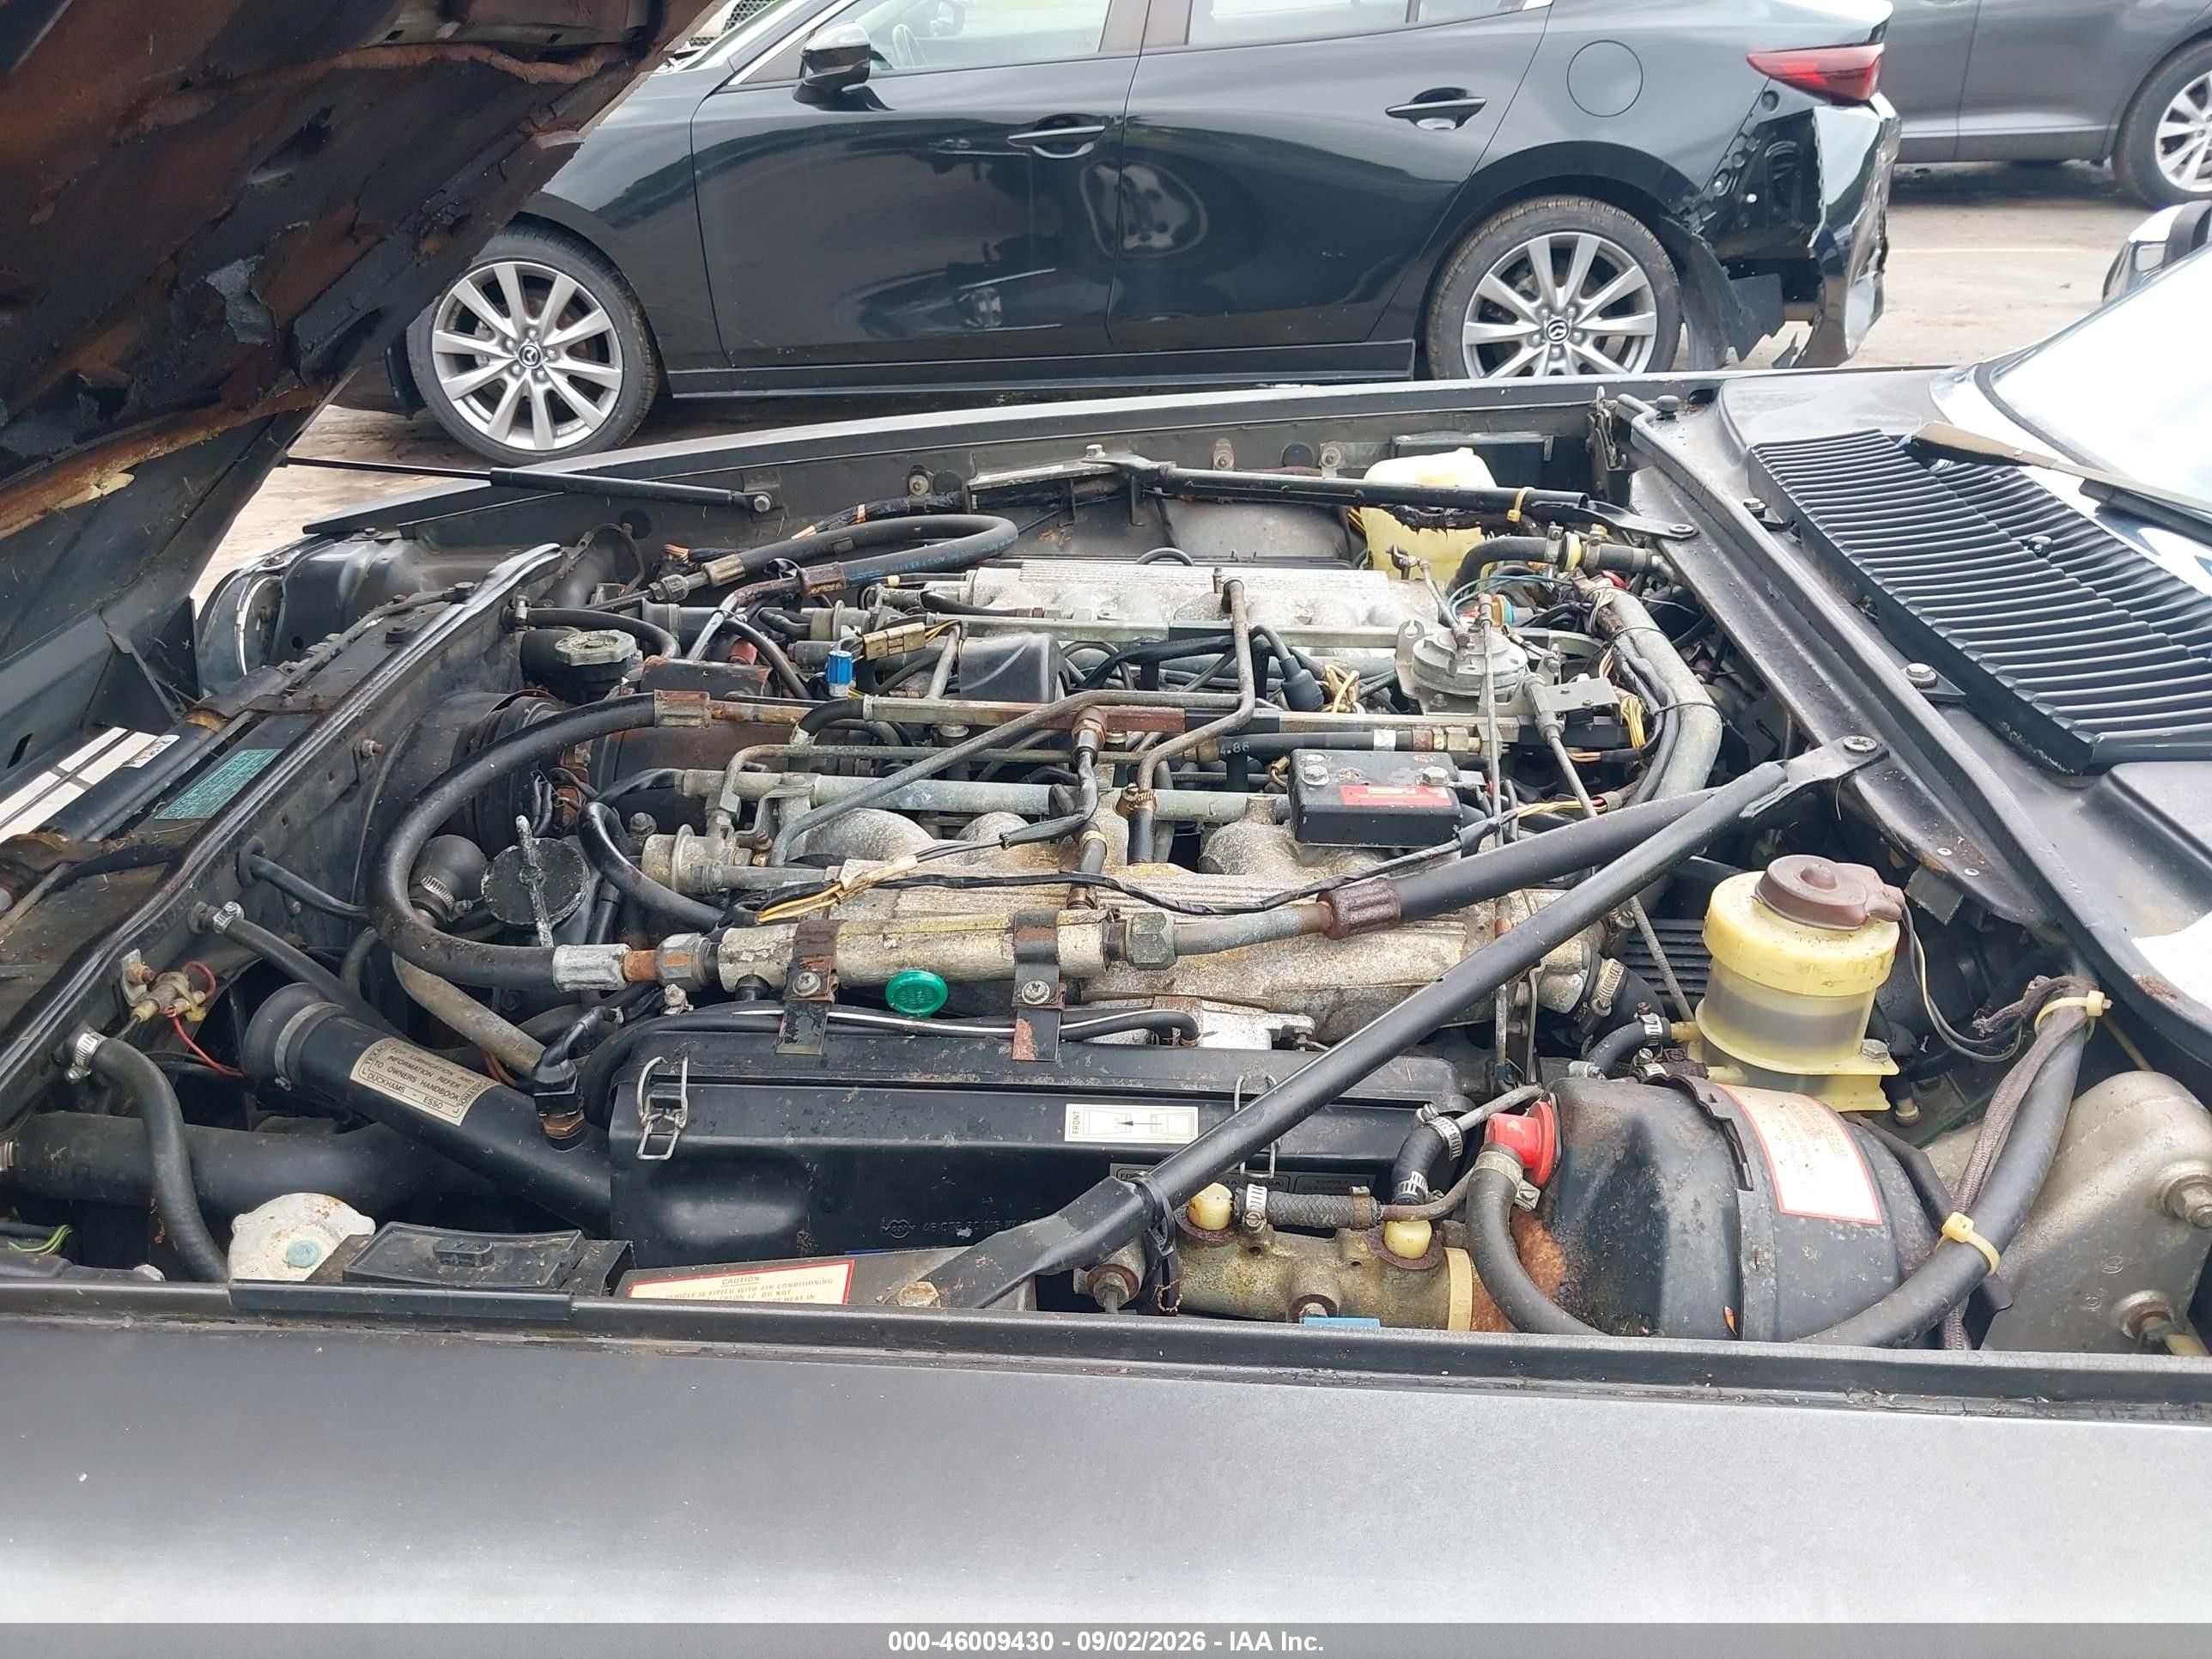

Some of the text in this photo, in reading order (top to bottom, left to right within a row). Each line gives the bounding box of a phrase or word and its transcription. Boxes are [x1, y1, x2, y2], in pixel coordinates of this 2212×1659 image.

[372, 1060, 385, 1070] TO
[386, 1066, 418, 1084] OWNERS
[419, 1079, 460, 1102] HANDBOOK
[386, 1054, 434, 1078] INFORMATION
[437, 1075, 462, 1090] REFER
[390, 1047, 476, 1085] FOR LUBRICATION AND
[366, 1073, 407, 1094] DUCKHAMS
[422, 1096, 444, 1110] ESSO
[1072, 1110, 1080, 1134] FRONT
[721, 1276, 760, 1285] CAUTION
[738, 1285, 758, 1294] WITH
[777, 1278, 833, 1289] CONDITIONING
